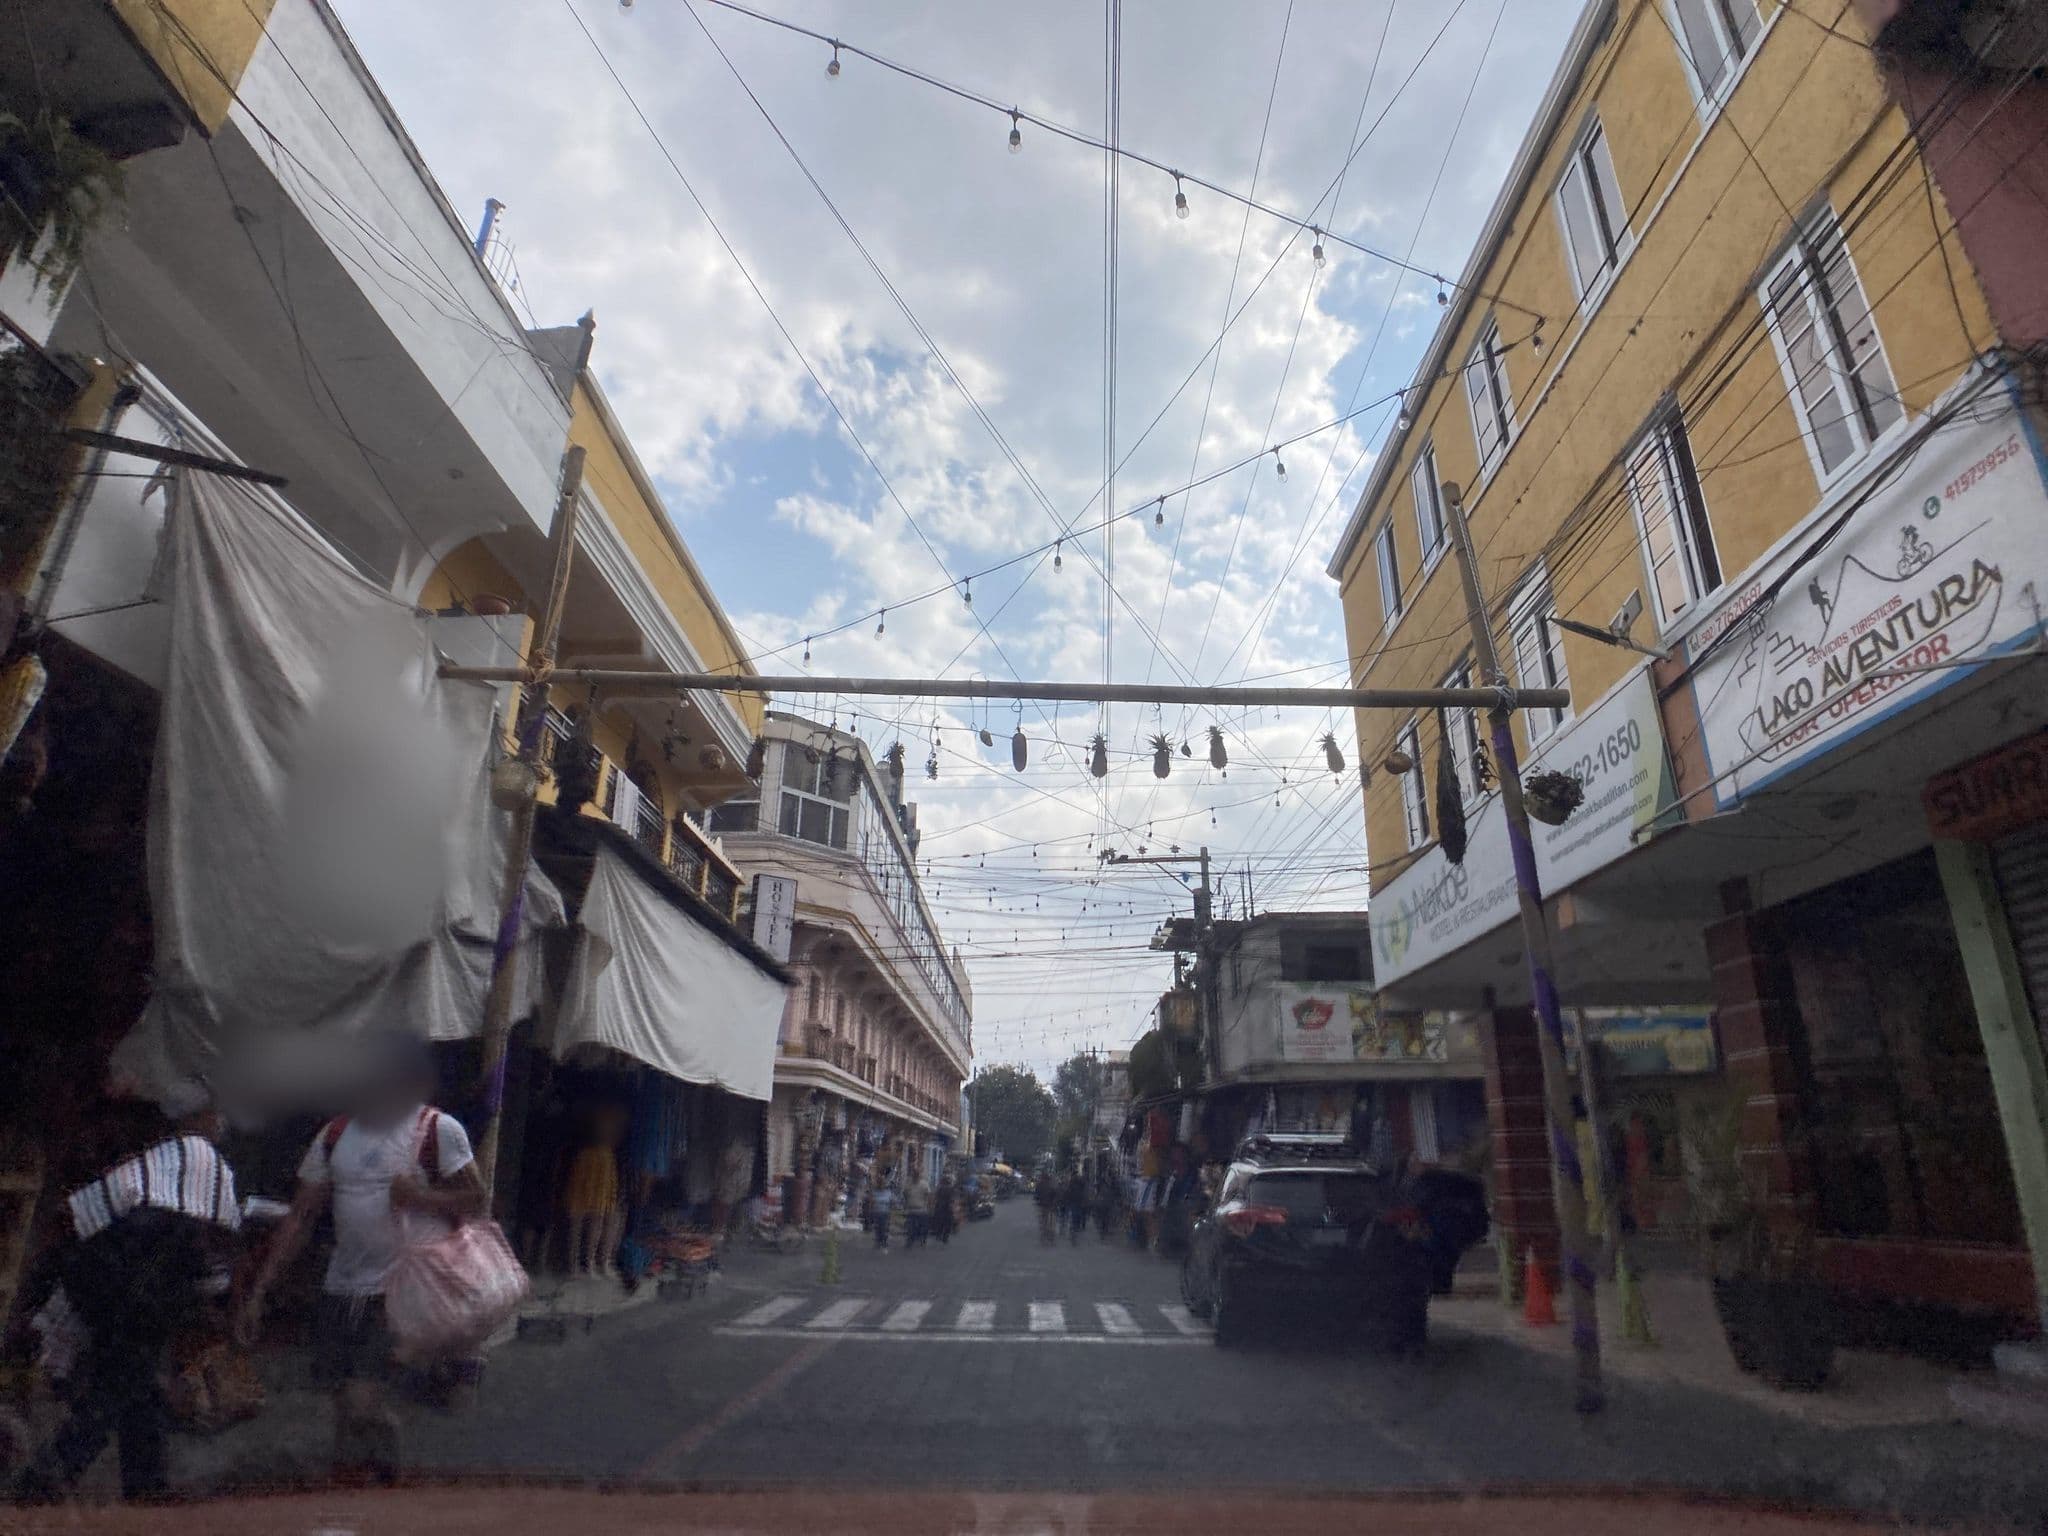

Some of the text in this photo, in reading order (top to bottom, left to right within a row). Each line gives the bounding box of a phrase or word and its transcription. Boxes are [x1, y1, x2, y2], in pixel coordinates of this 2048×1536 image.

[1757, 558, 2004, 738] LAGO AVENTURA
[1806, 631, 1850, 668] SERVICIOS
[1827, 632, 1952, 719] OPERATOR
[1563, 718, 1642, 791] 62-1650
